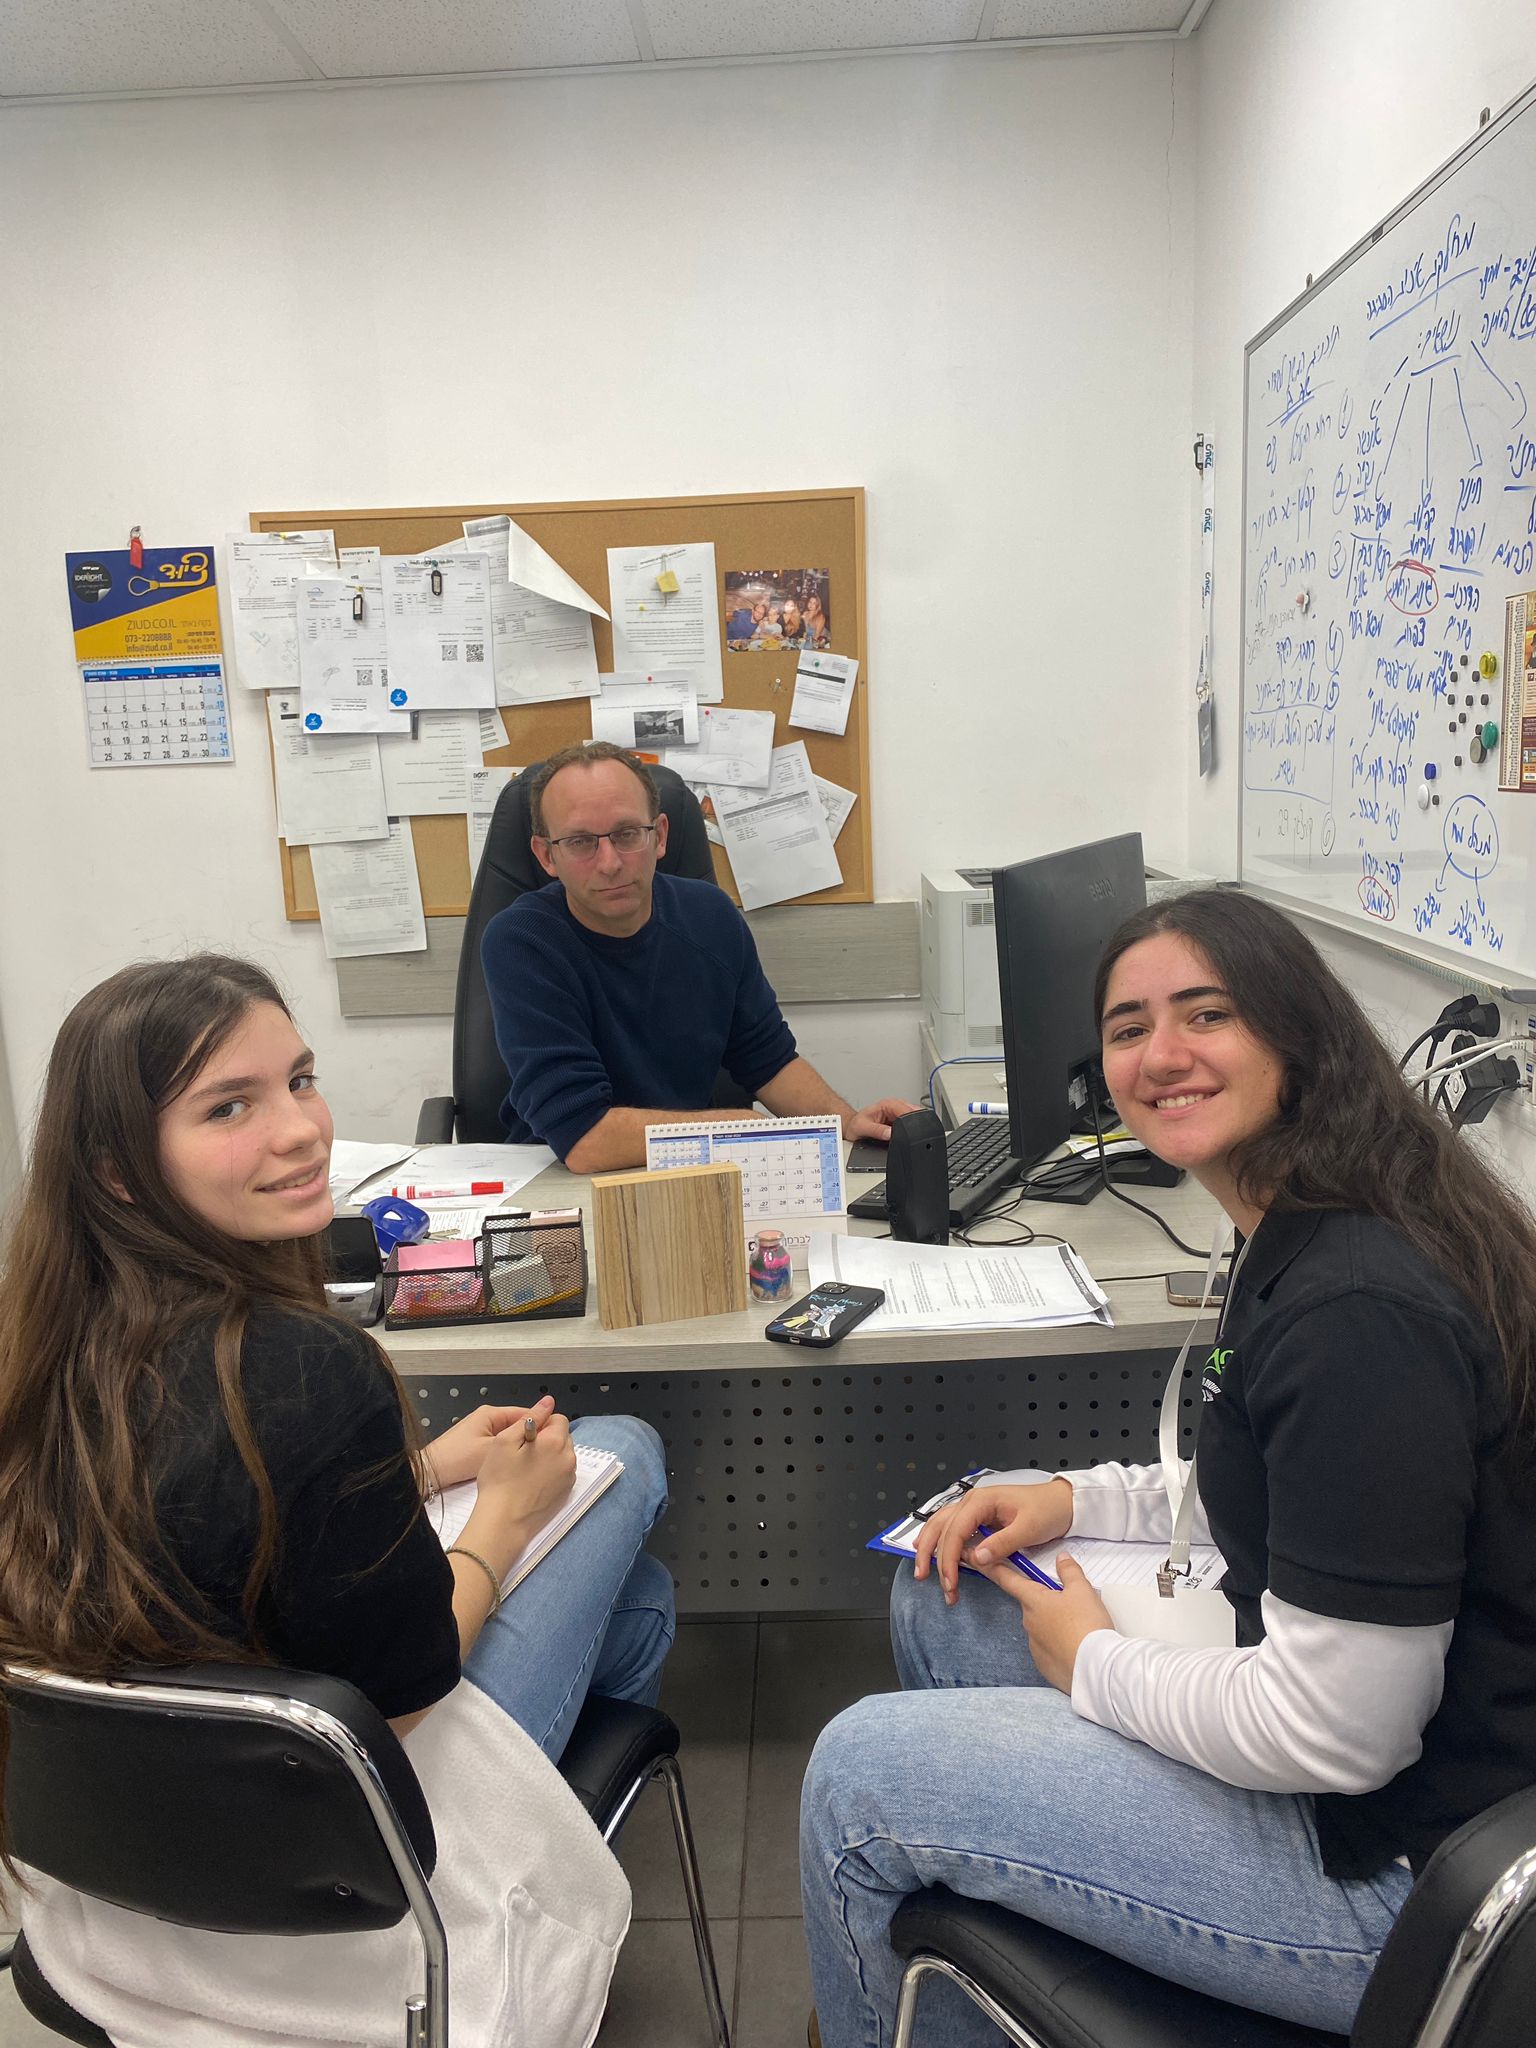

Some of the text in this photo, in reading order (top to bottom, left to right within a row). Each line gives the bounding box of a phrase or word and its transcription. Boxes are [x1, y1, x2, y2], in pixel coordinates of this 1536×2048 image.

[218, 717, 225, 725] 17
[161, 735, 169, 743] 21
[219, 733, 227, 741] 24
[105, 753, 112, 761] 25
[182, 750, 190, 758] 29
